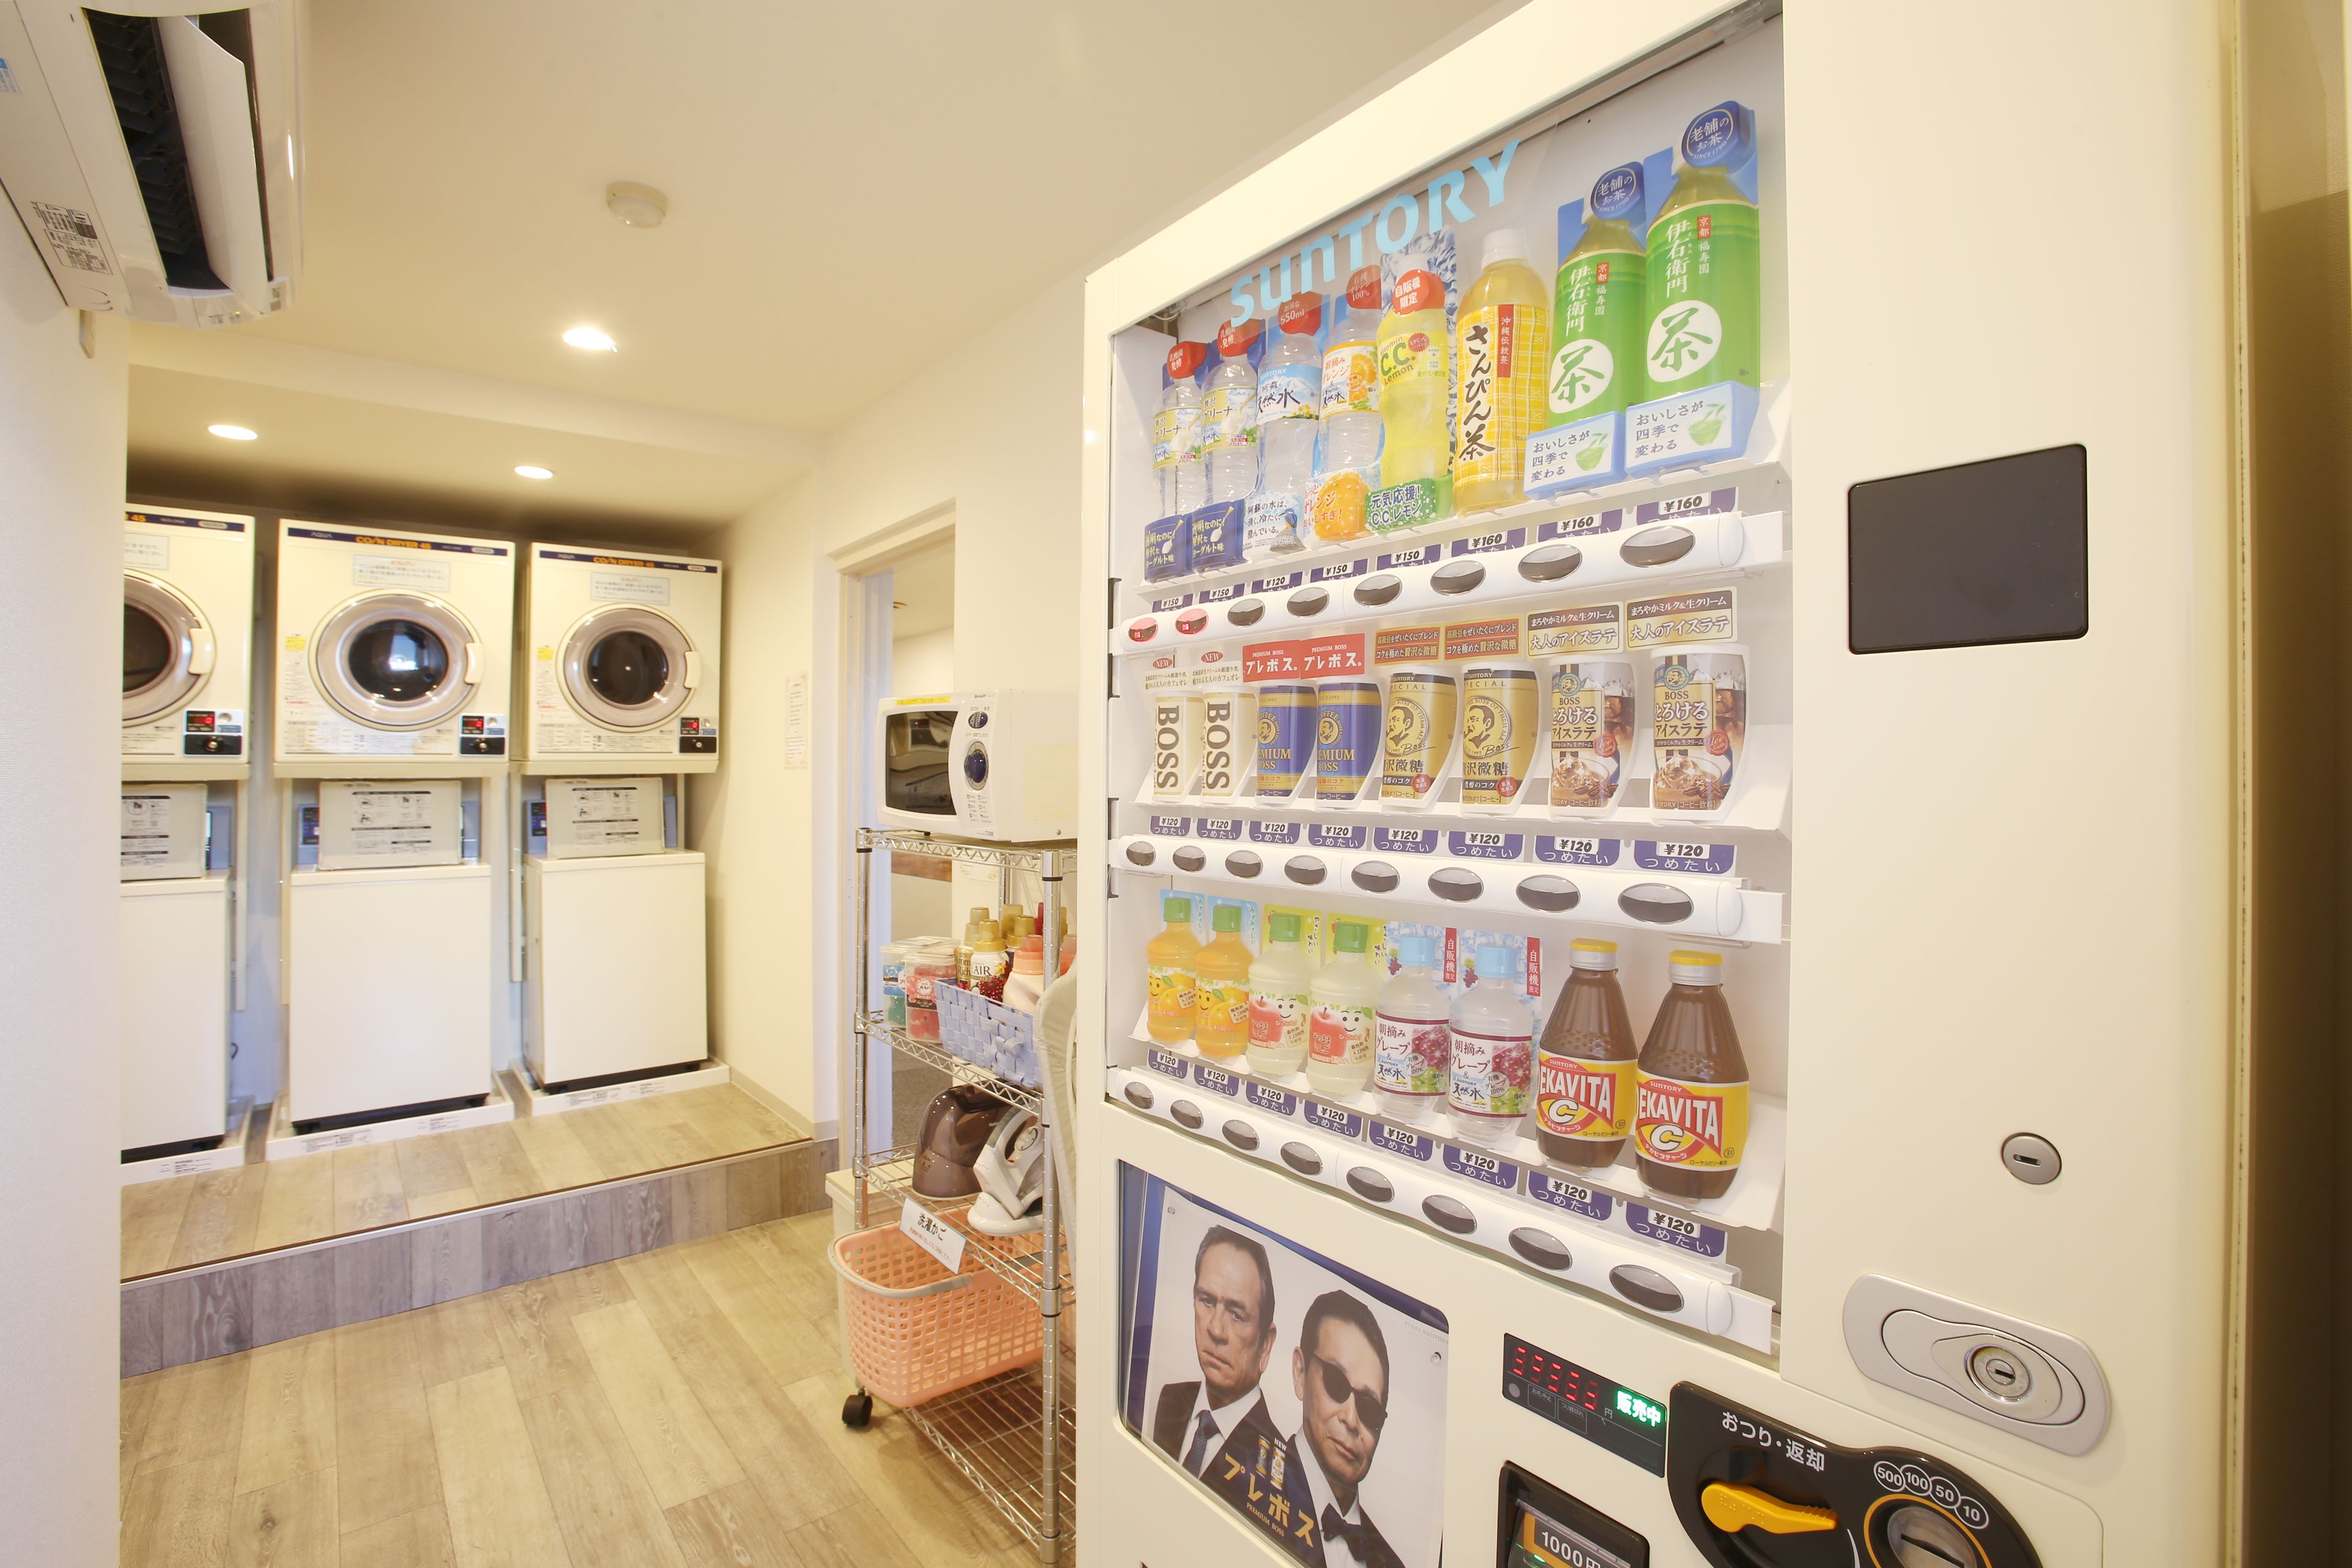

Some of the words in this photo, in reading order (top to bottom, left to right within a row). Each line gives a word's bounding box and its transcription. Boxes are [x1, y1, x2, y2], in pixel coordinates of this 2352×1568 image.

[1691, 116, 1729, 143] 老舗の
[1697, 133, 1722, 151] お茶
[1598, 175, 1632, 197] 老舗の
[1603, 190, 1626, 205] お茶
[1230, 137, 1521, 327] SUNTORY
[1699, 216, 1709, 236] 京都
[1665, 219, 1690, 298] 伊右衛門
[1395, 276, 1420, 298] 自販機
[1352, 290, 1370, 302] 100%
[1400, 292, 1418, 309] 限定
[1566, 265, 1588, 336] 伊右衛門
[1280, 309, 1305, 325] 550ml
[1380, 336, 1403, 355] Vitamin
[1651, 307, 1713, 372] 茶
[1380, 342, 1415, 376] C.C.
[1384, 364, 1414, 385] Lemon
[1551, 345, 1605, 404] 茶
[1459, 325, 1495, 461] さんぴん茶
[1637, 401, 1703, 426] おいしさが
[1637, 423, 1678, 441] 四季で
[1533, 430, 1589, 453] おいしさが
[1635, 440, 1676, 458] 変わる
[1532, 451, 1567, 467] 四季で
[1531, 466, 1565, 483] 変わる
[1664, 496, 1703, 513] ¥160
[1561, 516, 1594, 531] ¥160
[387, 539, 418, 549] DRYER
[1472, 533, 1502, 548] ¥160
[1395, 551, 1420, 562] ¥150
[1325, 564, 1348, 576] ¥150
[1265, 577, 1286, 587] ¥120
[1212, 589, 1229, 598] ¥150
[1163, 598, 1179, 607] ¥150
[1631, 597, 1726, 616] まろやかミルク&生クリーム
[1531, 611, 1614, 627] まろやかミルク&生クリーム
[1447, 623, 1517, 638] 高級豆をぜいたくにブレンド
[1630, 616, 1729, 641] 大人のアイスラテ
[1446, 639, 1517, 654] コクを極めた贅沢な微糖
[1531, 628, 1617, 649] 大人のアイスラテ
[1205, 653, 1220, 662] NEW
[1376, 646, 1437, 659] コクを極めた贅沢な微糖
[1246, 657, 1297, 675] プレボス。
[1304, 652, 1362, 671] プレボス。
[1665, 691, 1689, 700] BOSS
[1656, 701, 1709, 721] とろける
[1656, 723, 1708, 737] アイスラテ
[1157, 706, 1179, 788] BOSS
[1206, 701, 1230, 789] BOSS
[1201, 829, 1236, 839] つめたい
[1264, 823, 1285, 832] ¥120
[1325, 826, 1349, 836] ¥120
[1392, 830, 1419, 840] ¥120
[1254, 833, 1293, 843] つめたい
[1314, 837, 1359, 848] つめたい
[1380, 841, 1429, 852] つめたい
[1469, 833, 1500, 844] ¥120
[1559, 840, 1593, 853] ¥120
[1457, 846, 1512, 858] つめたい
[1544, 852, 1608, 864] つめたい
[1664, 844, 1703, 856] ¥120
[1645, 858, 1720, 872] つめたい
[1446, 938, 1455, 973] 自販機
[1529, 950, 1539, 986] 自販機
[1379, 1023, 1406, 1038] 朝摘み
[1376, 1036, 1411, 1055] グレープ
[1455, 1039, 1485, 1055] 朝摘み
[1159, 1054, 1175, 1065] ¥120
[1451, 1053, 1490, 1073] グレープ
[1550, 1058, 1578, 1069] SUNTORY
[1152, 1061, 1182, 1077] つめたい
[1206, 1069, 1225, 1082] ¥120
[1378, 1064, 1406, 1080] 天然水
[1199, 1077, 1233, 1095] つめたい
[1260, 1087, 1281, 1101] ¥120
[1453, 1083, 1484, 1101] 天然水
[1540, 1066, 1611, 1120] EKAVITA
[1650, 1080, 1682, 1092] SUNTORY
[1251, 1095, 1289, 1114] つめたい
[1548, 1099, 1578, 1124] C
[1320, 1106, 1344, 1122] ¥120
[1640, 1088, 1719, 1147] EKAVITA
[1310, 1115, 1354, 1135] つめたい
[1387, 1128, 1414, 1144] ¥120
[1376, 1136, 1424, 1159] つめたい
[1464, 1153, 1495, 1170] ¥120
[1451, 1162, 1507, 1186] つめたい
[1553, 1180, 1588, 1200] ¥120
[1537, 1190, 1600, 1217] つめたい
[918, 1213, 946, 1240] 洗濯かご
[1654, 1213, 1695, 1234] ¥120
[1636, 1223, 1711, 1253] つめたい
[1604, 1407, 1613, 1419] 円
[1617, 1390, 1661, 1427] 販売中
[1275, 1438, 1287, 1451] NEW
[1722, 1411, 1825, 1472] おつり・返却
[1877, 1468, 1902, 1485] 500
[1906, 1471, 1928, 1490] 100
[1224, 1453, 1314, 1548] プレボス
[1936, 1485, 1954, 1502] 50
[1246, 1502, 1270, 1526] PREMIUM
[1272, 1523, 1284, 1536] BOSS
[1964, 1504, 1980, 1521] 10
